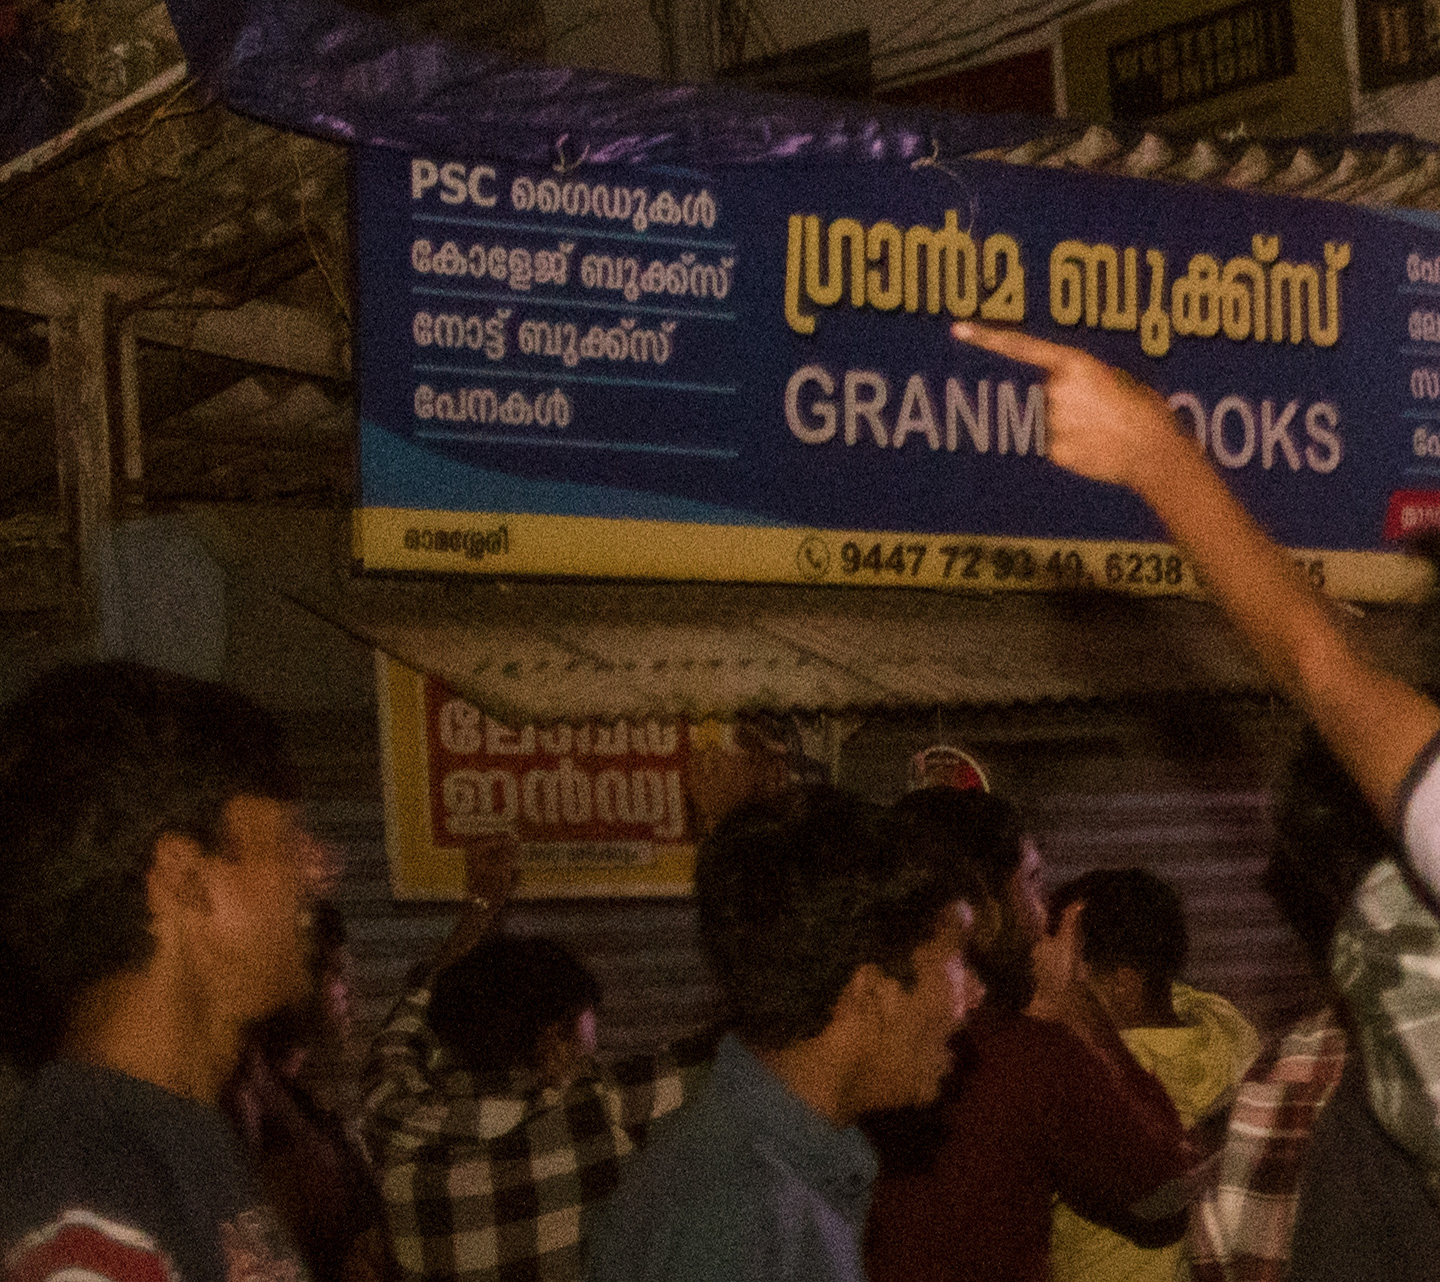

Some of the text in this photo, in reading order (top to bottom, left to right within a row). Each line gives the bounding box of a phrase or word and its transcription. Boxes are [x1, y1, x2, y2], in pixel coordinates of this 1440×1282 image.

[410, 158, 499, 207] PSC
[411, 383, 574, 428] പേനകൾ
[784, 364, 1344, 475] GRANM OKS
[841, 540, 927, 577] 9447
[939, 544, 981, 579] 72
[1105, 551, 1184, 586] 6238
